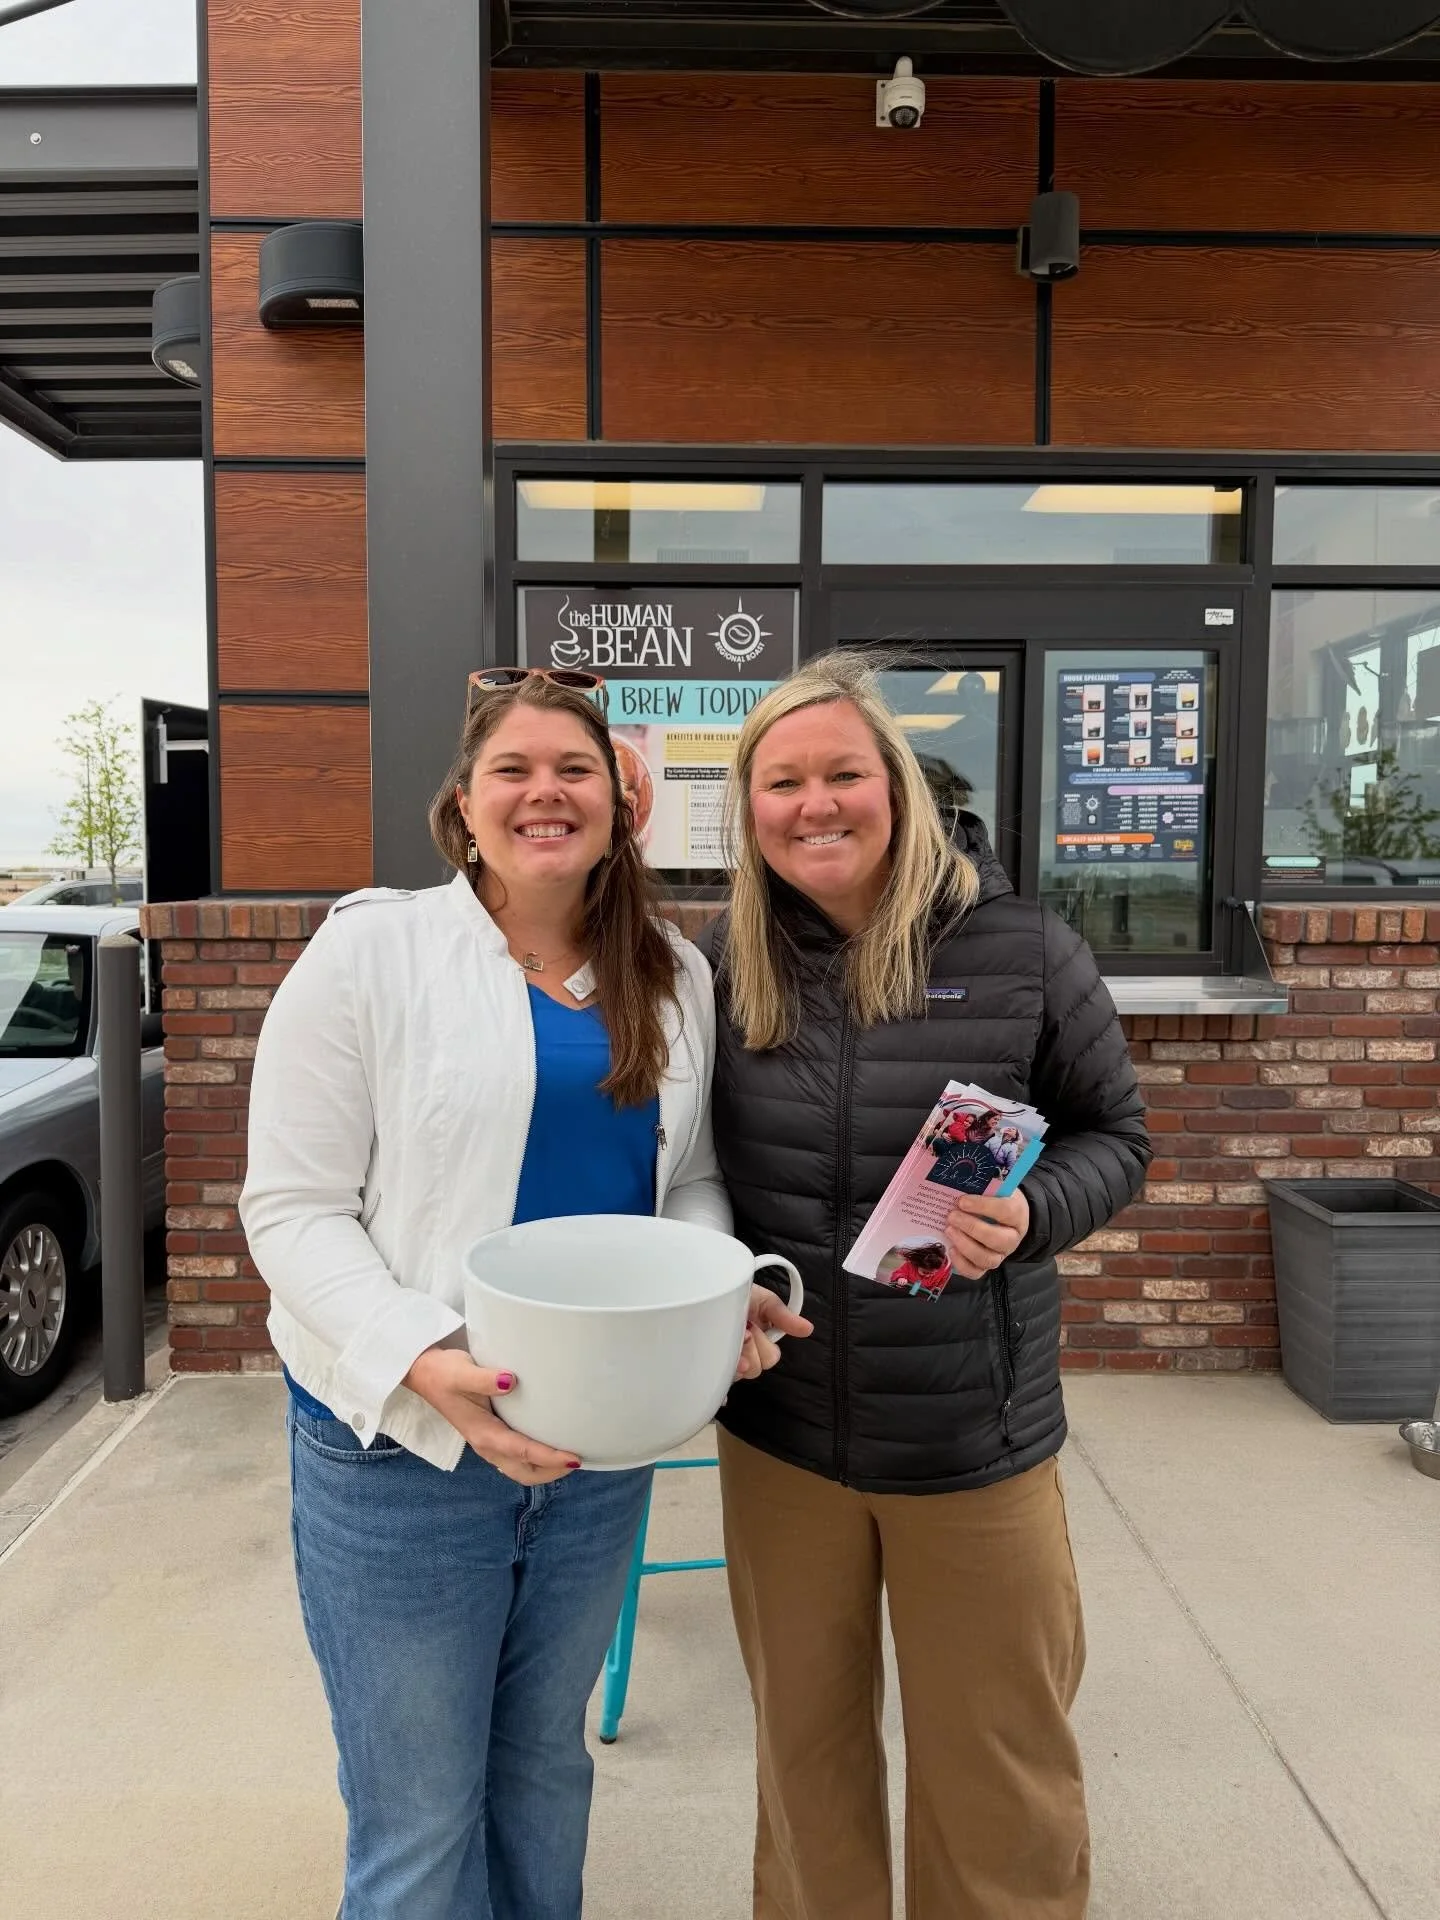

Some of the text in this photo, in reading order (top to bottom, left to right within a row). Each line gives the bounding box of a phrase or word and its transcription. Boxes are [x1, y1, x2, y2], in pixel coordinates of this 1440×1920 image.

[569, 604, 673, 626] the HUMAN
[588, 627, 694, 667] BEAN
[714, 641, 765, 663] REGIONAL ROAST
[621, 686, 684, 717] BREW
[666, 733, 693, 741] BENEFITS
[694, 733, 701, 741] OF
[703, 733, 714, 741] OUR
[716, 733, 730, 741] COLD
